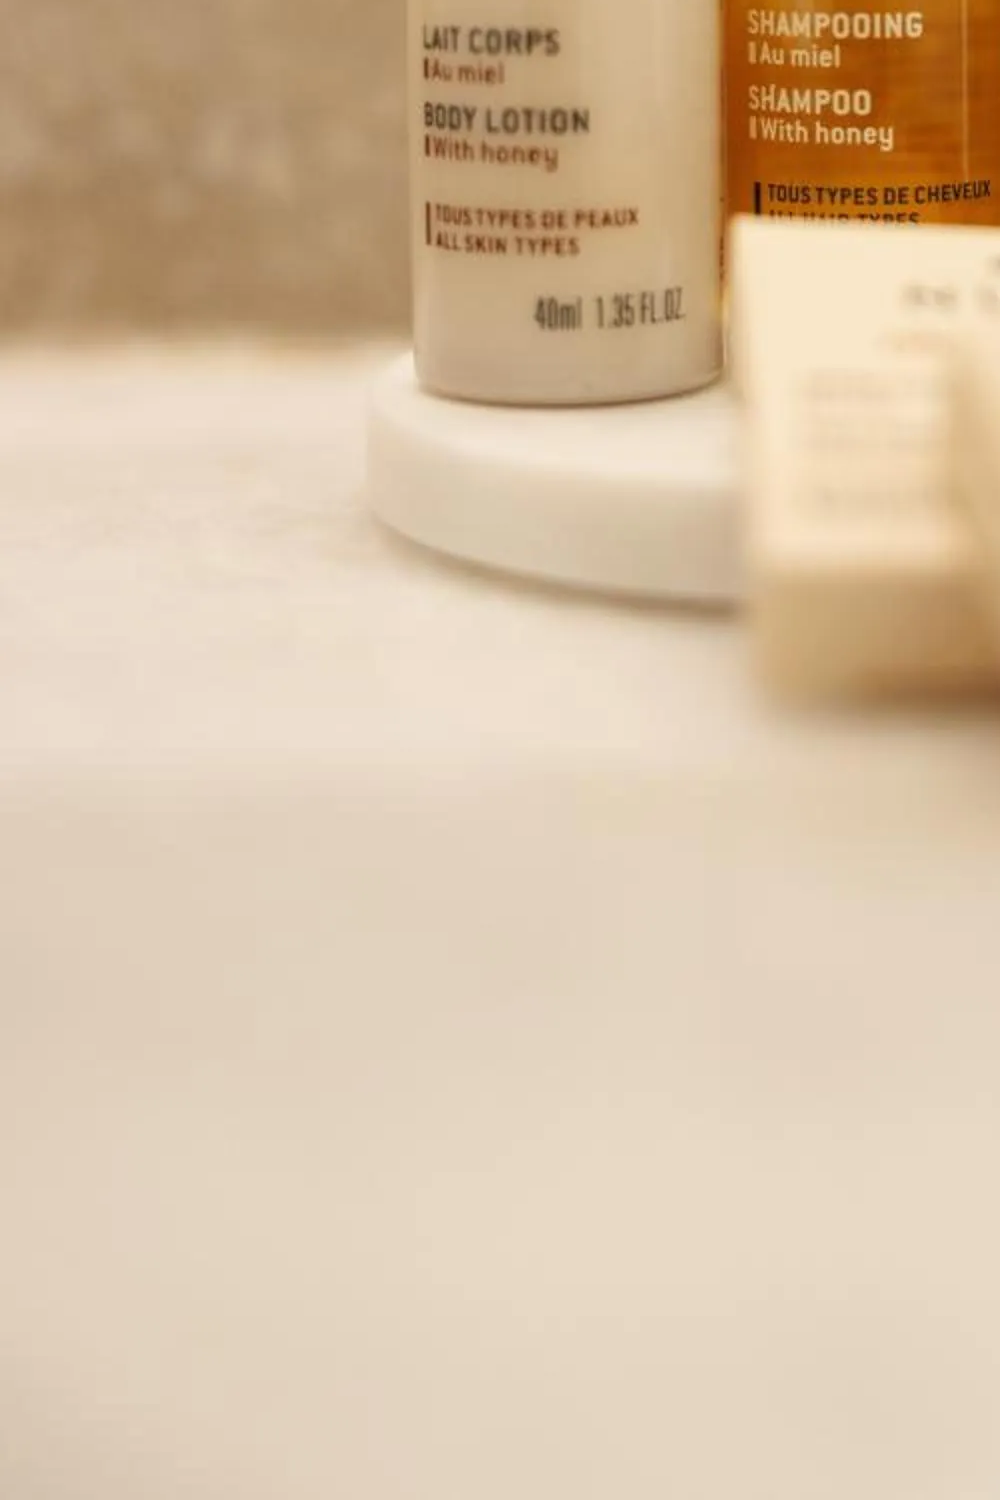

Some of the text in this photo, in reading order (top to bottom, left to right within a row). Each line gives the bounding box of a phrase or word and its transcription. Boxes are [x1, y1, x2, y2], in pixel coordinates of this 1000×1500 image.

[422, 24, 561, 56] LAIT CORPS
[748, 9, 924, 40] SHAMPOOING
[759, 42, 841, 68] Au miel
[431, 60, 505, 84] Au miel
[748, 85, 872, 116] SHAMPOO
[423, 101, 591, 135] BODY LOTION
[760, 117, 894, 152] With honey
[432, 136, 559, 173] With honey
[767, 180, 991, 206] TOUS TYPES DE CHEVEUX
[436, 203, 640, 230] TOUS TYPES DE PEAUX
[436, 231, 580, 257] ALL SKIN TYPES
[533, 296, 582, 331] 40ml
